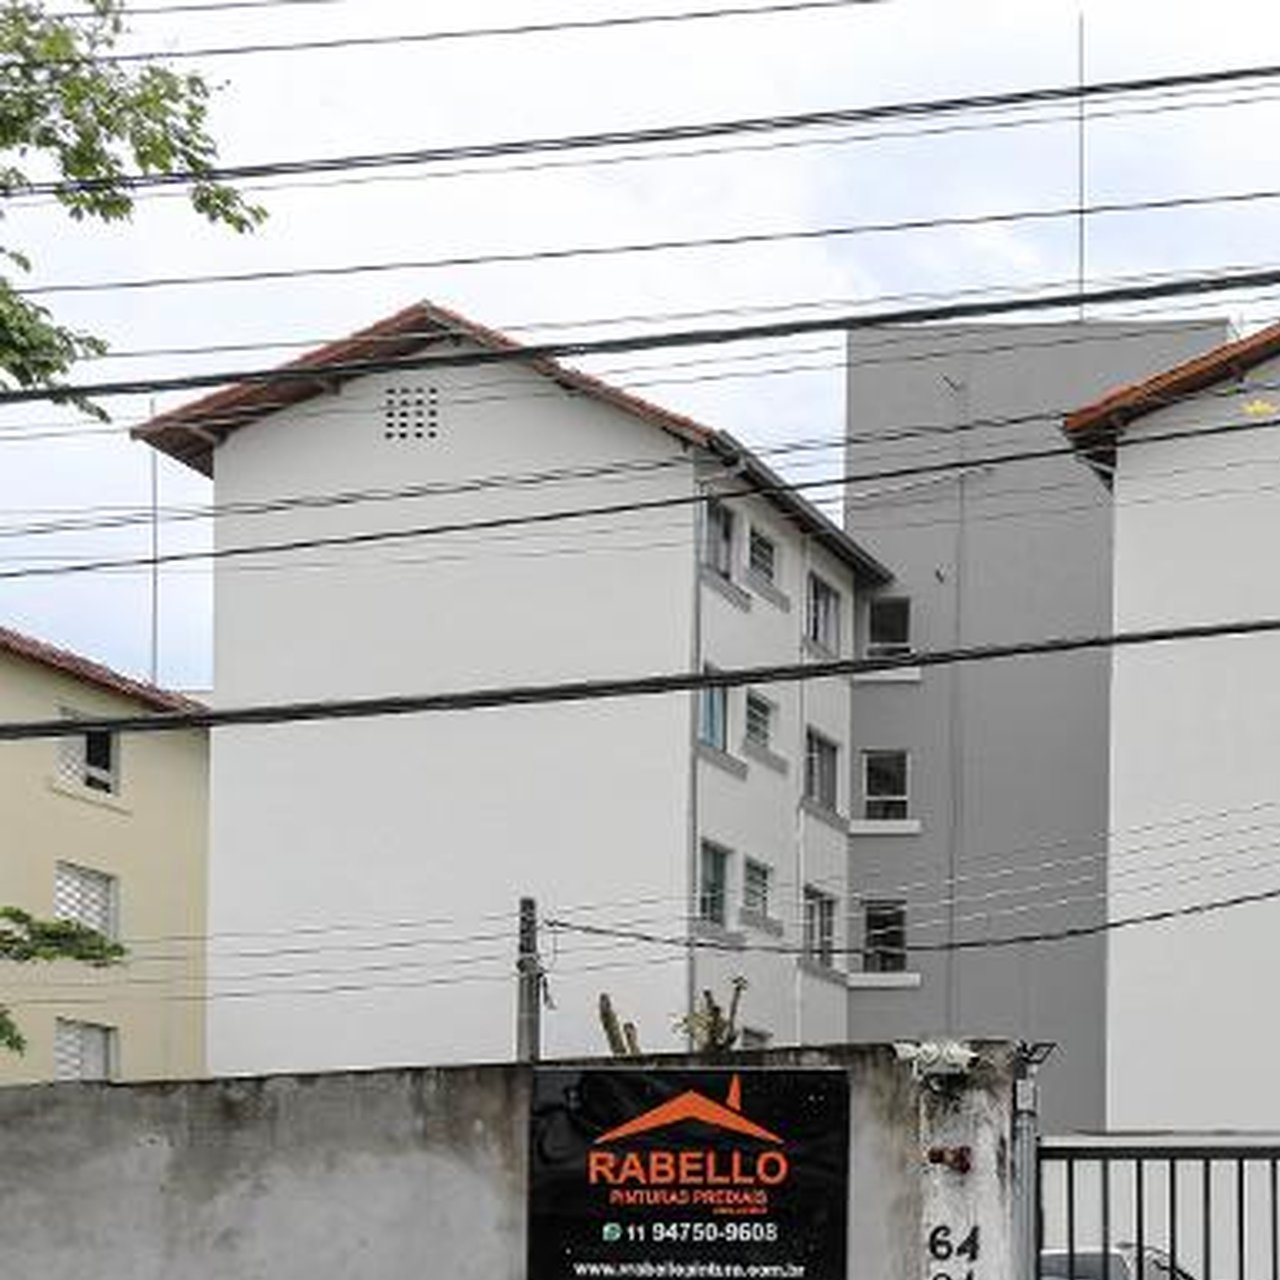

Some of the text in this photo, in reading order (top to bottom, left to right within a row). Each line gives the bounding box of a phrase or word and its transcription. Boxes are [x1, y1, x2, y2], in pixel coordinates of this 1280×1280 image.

[588, 1151, 788, 1184] RABELLO
[627, 1223, 645, 1242] 11
[929, 1225, 980, 1261] 64
